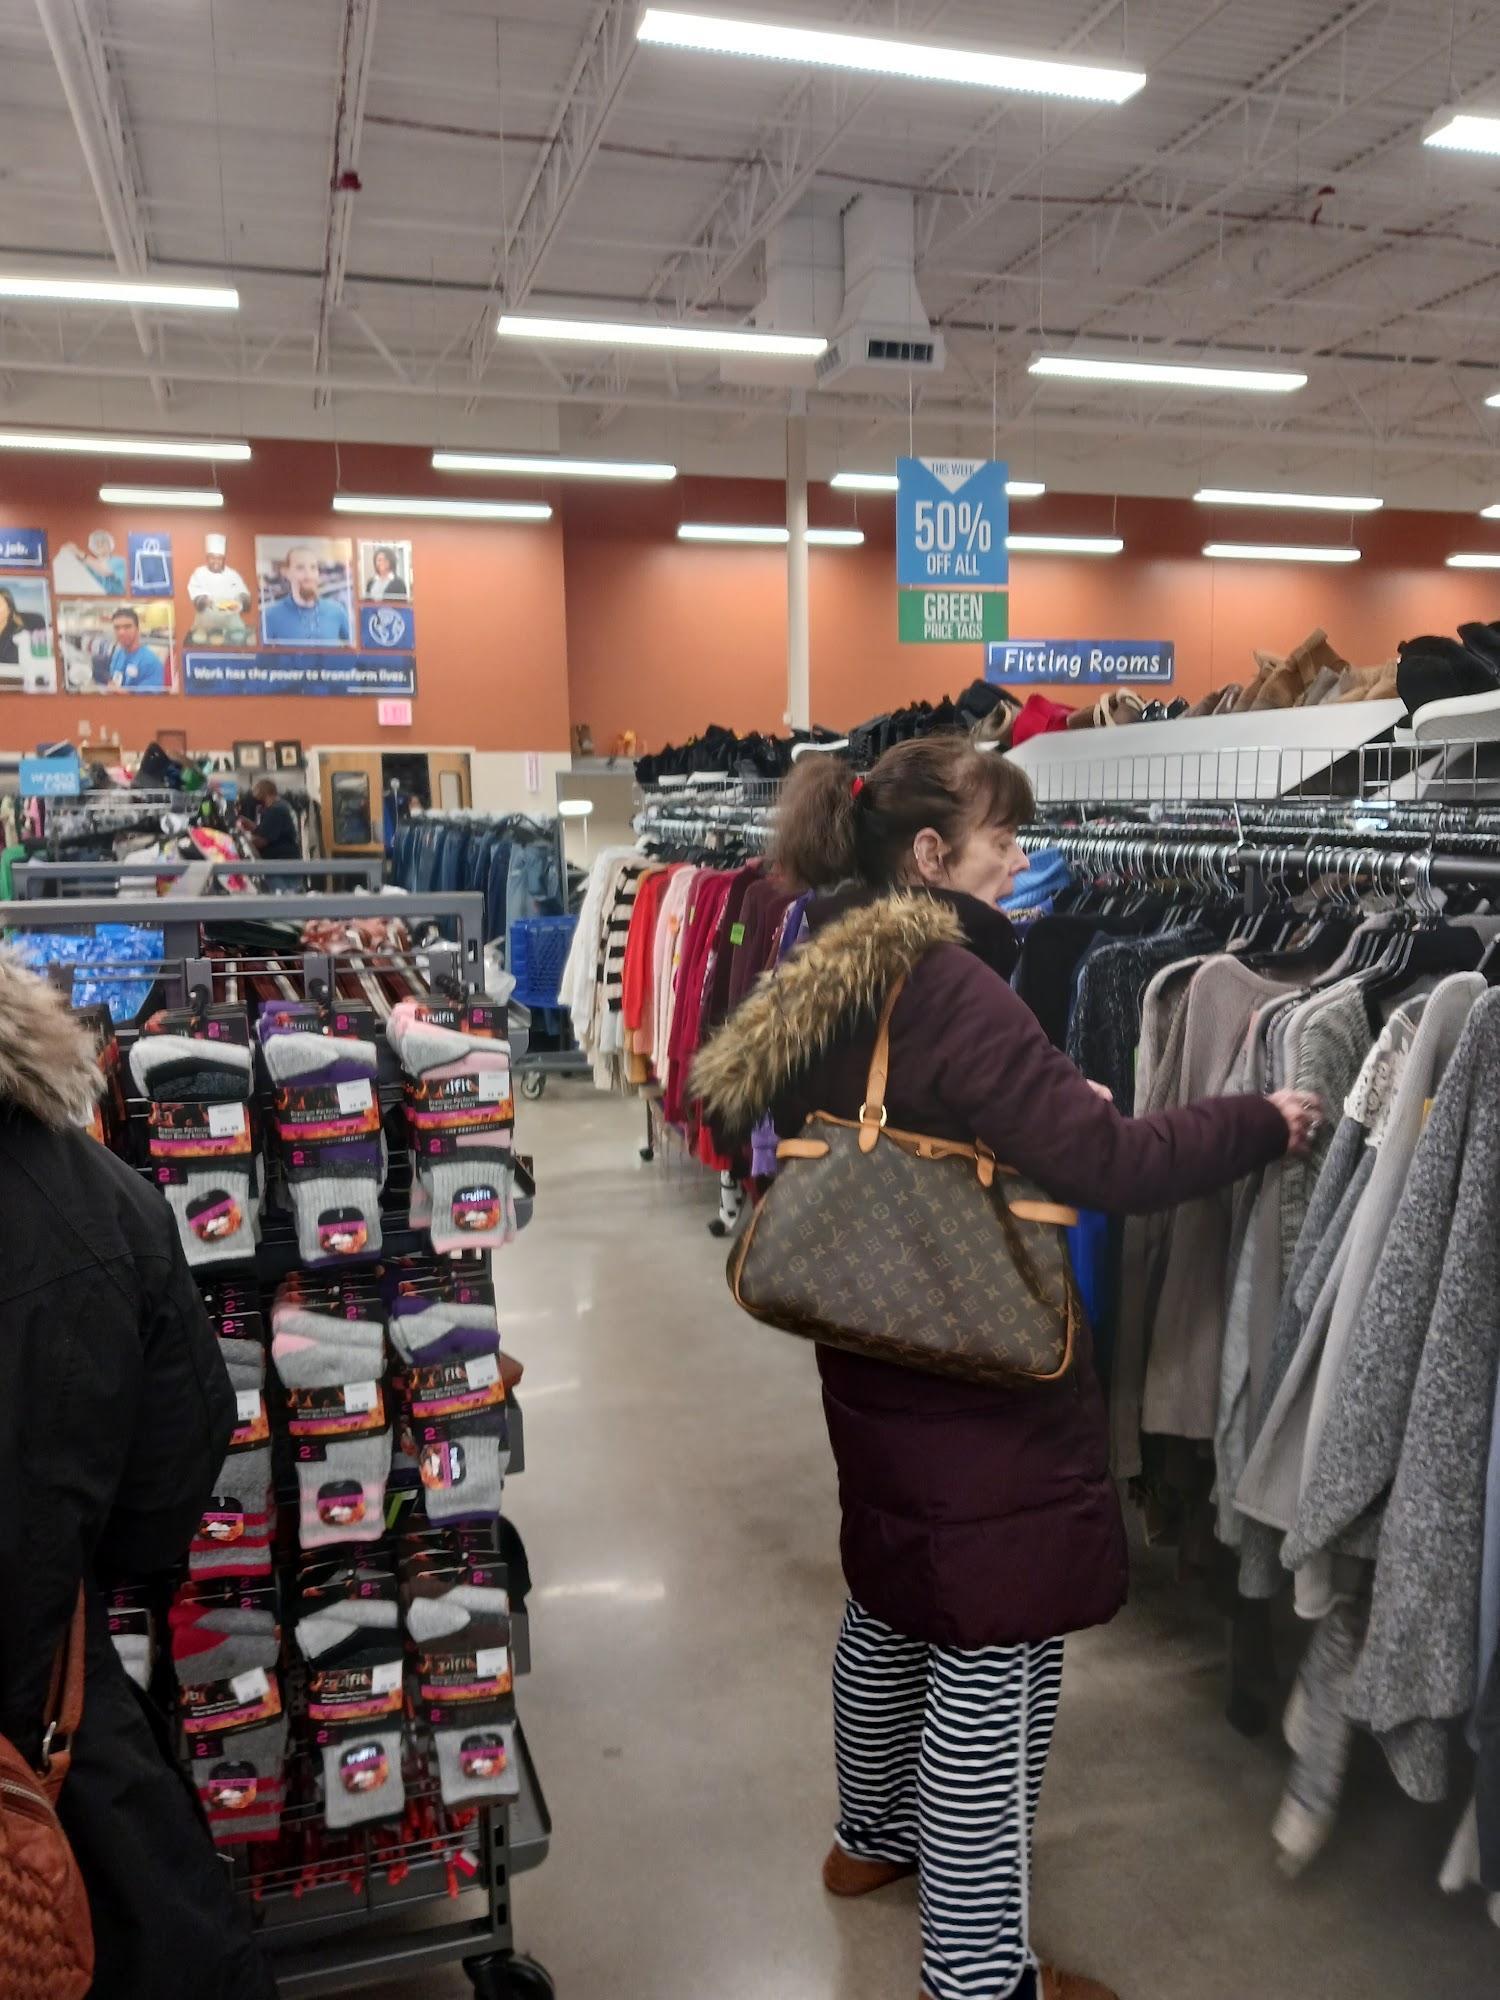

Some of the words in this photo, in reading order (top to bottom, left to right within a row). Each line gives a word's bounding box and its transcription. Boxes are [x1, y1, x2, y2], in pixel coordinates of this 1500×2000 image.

[932, 463, 949, 476] THIS
[951, 464, 975, 477] WEEK
[915, 500, 991, 552] 50%
[927, 553, 951, 576] OFF
[954, 554, 980, 576] ALL
[924, 592, 983, 622] GREEN
[924, 622, 953, 640] PRICE
[956, 622, 983, 640] TAGS
[1004, 649, 1081, 678] Fitting
[1089, 649, 1160, 673] Rooms
[194, 667, 223, 681] Work
[226, 667, 246, 681] has
[248, 667, 268, 681] the
[270, 669, 304, 684] power
[306, 668, 319, 682] to
[321, 667, 377, 683] transform
[379, 668, 407, 683] lives.
[222, 1319, 235, 1334] 2
[299, 1446, 312, 1459] 2
